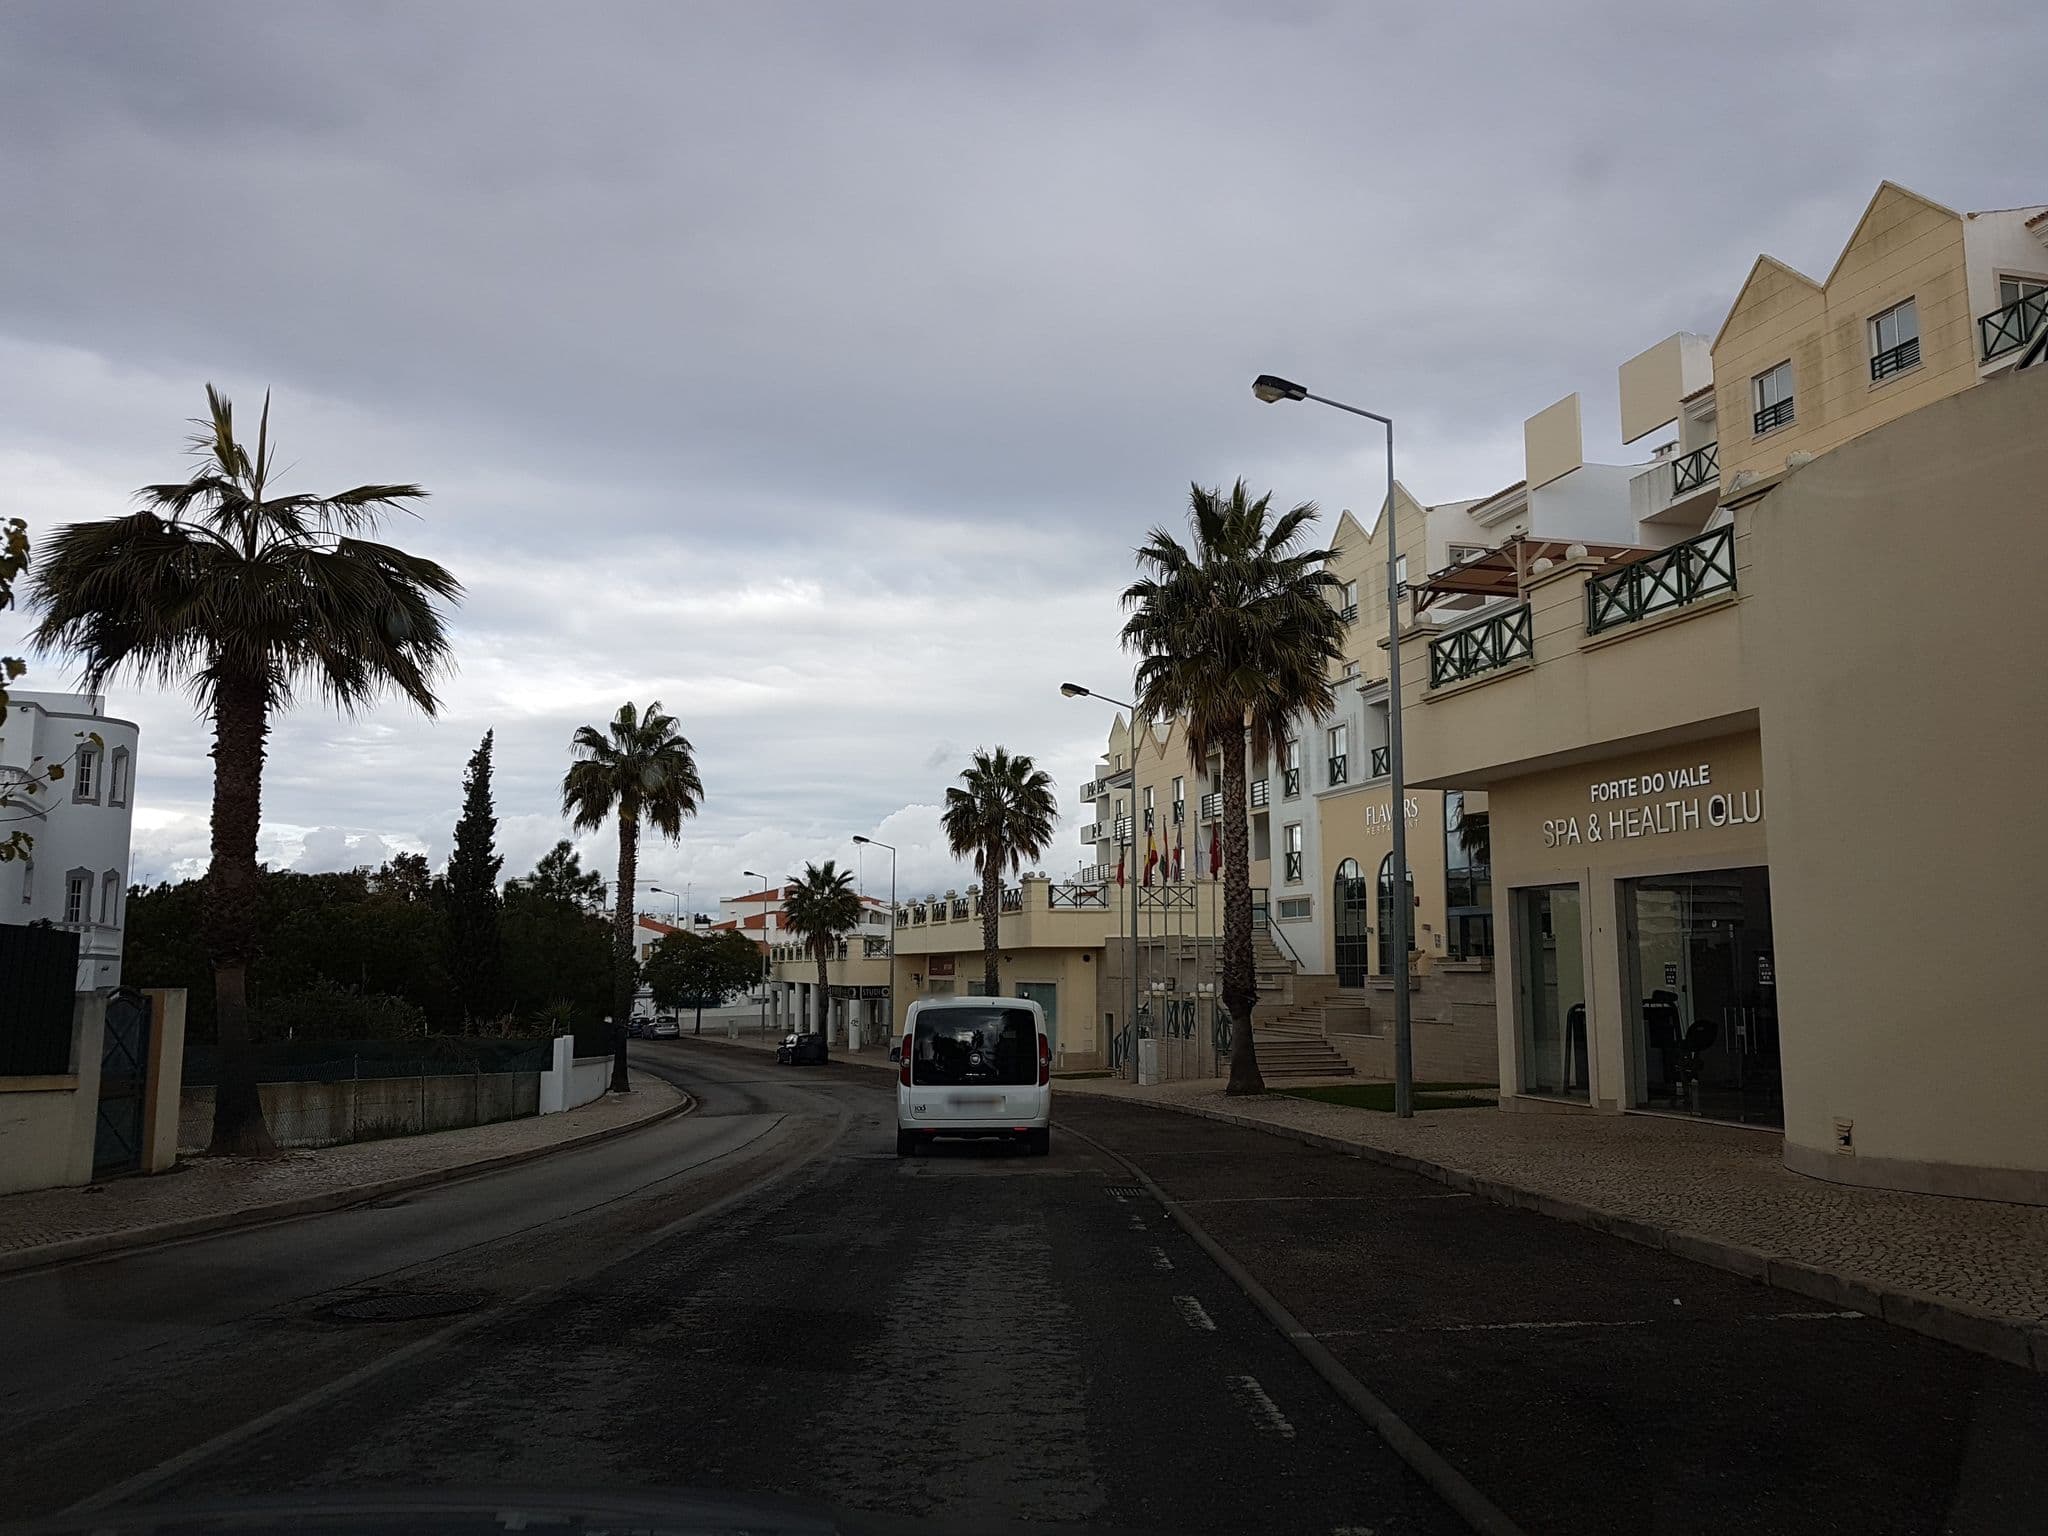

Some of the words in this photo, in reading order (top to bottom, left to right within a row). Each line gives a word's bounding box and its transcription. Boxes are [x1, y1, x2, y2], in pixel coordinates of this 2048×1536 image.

[1590, 777, 1638, 803] FORTE
[1641, 773, 1665, 794] DO
[1668, 764, 1711, 789] VALE
[1366, 796, 1418, 826] FLAVRS
[1543, 817, 1582, 848] SPA
[1587, 813, 1603, 842] &
[1609, 798, 1701, 840] HEALTH
